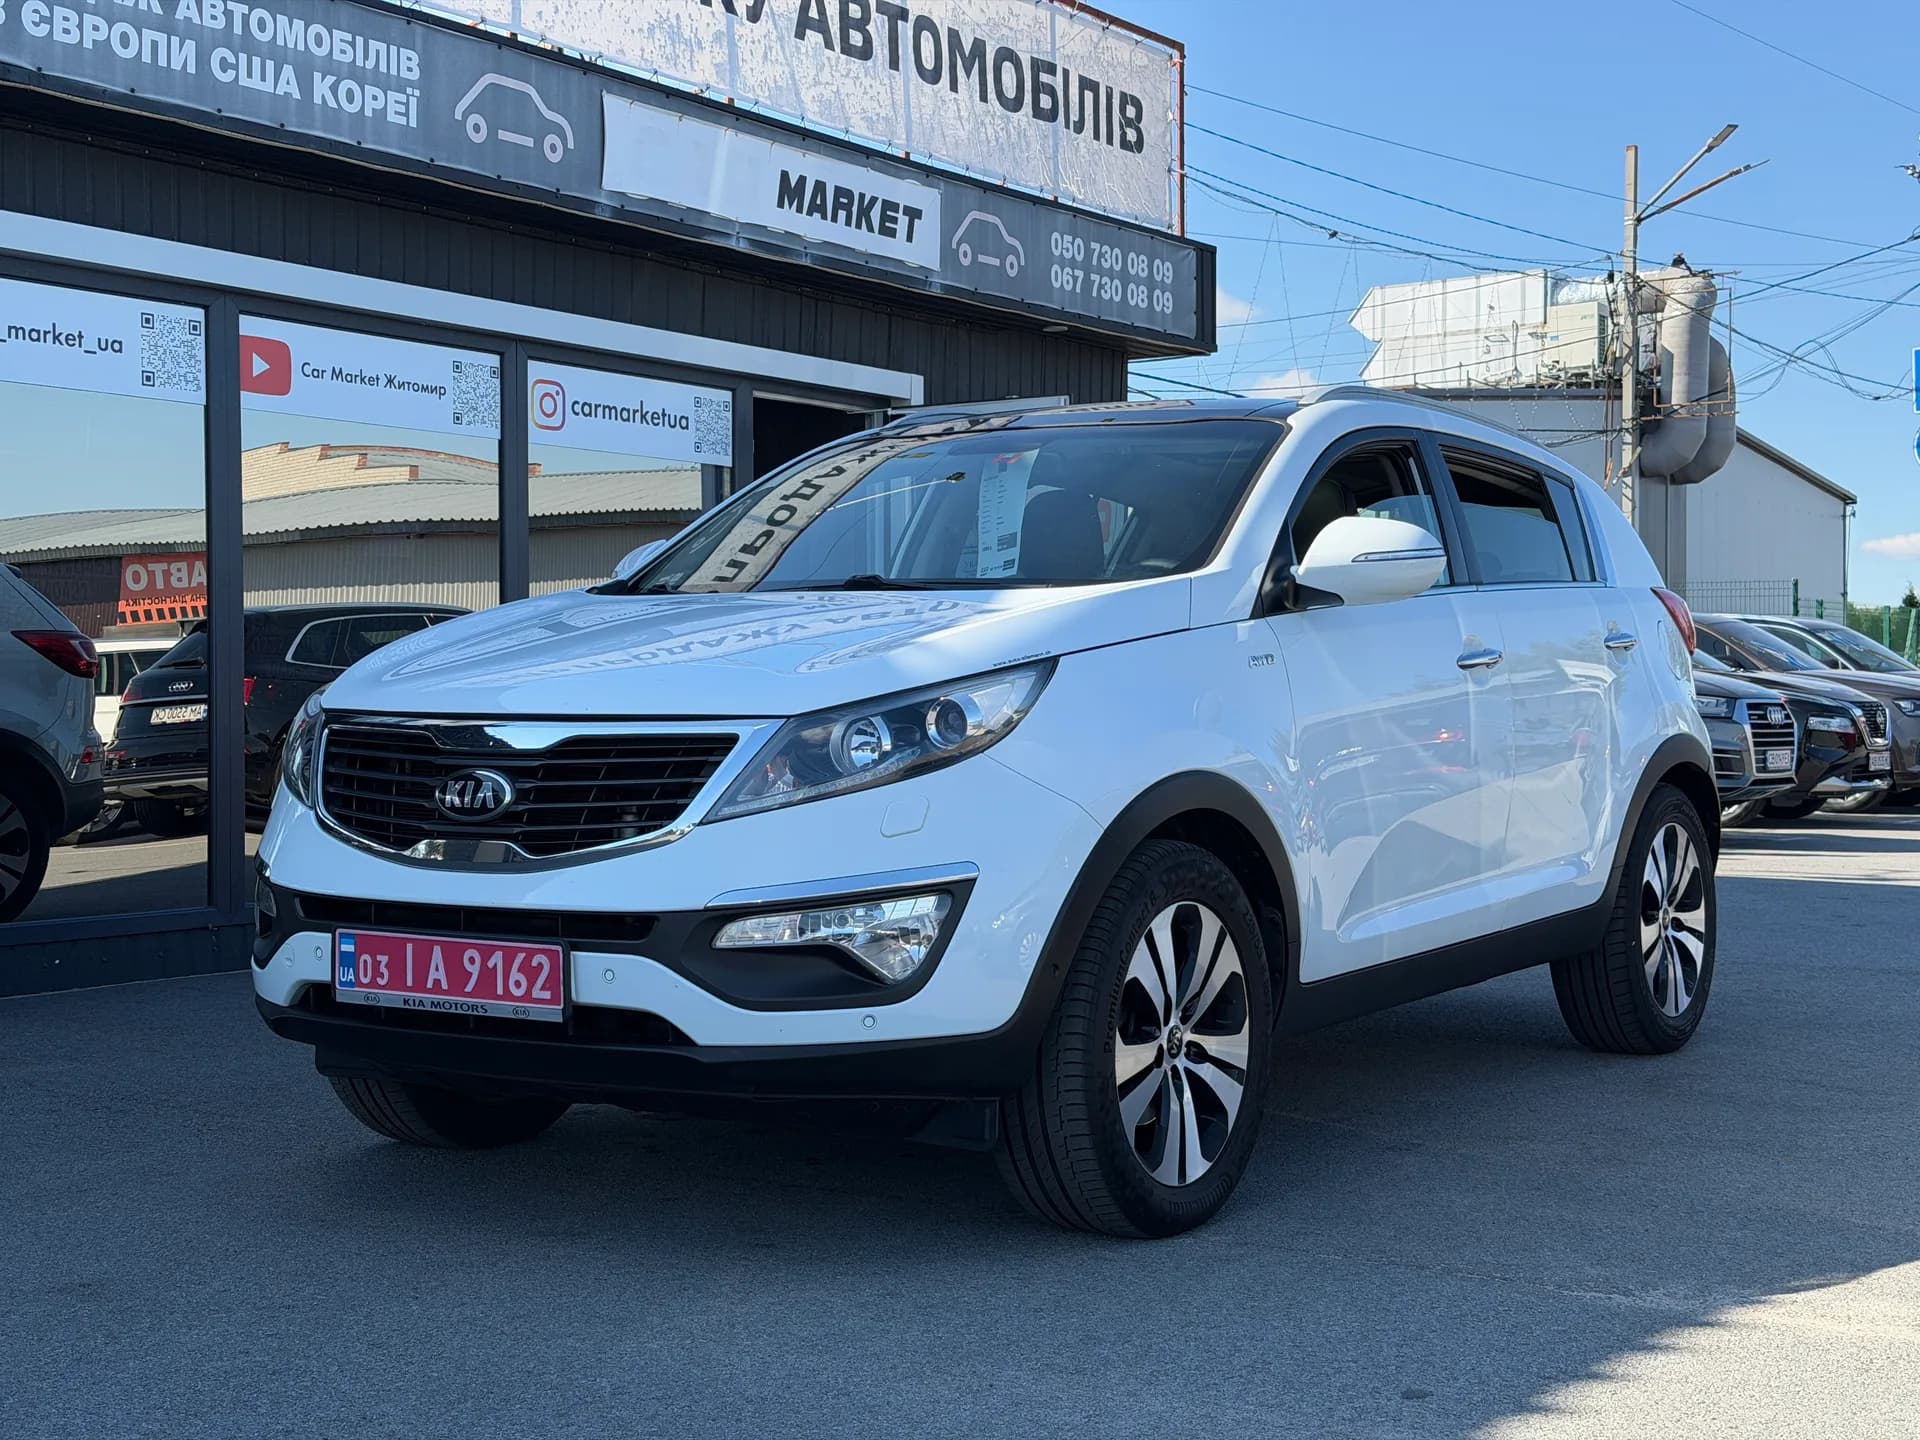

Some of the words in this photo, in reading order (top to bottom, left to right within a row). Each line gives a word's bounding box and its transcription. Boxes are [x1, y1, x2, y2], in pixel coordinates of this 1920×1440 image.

[21, 0, 196, 74] ЄВРОПИ
[210, 47, 301, 100] США
[313, 71, 420, 128] КОРЕЇ
[175, 0, 421, 81] АВТОМОБІЛІВ
[794, 0, 1145, 155] АВТОМОБІЛІВ
[776, 169, 923, 243] MARKET
[1051, 231, 1084, 262] 050
[1090, 242, 1122, 271] 730
[1127, 252, 1148, 278] 08
[1153, 259, 1173, 284] 09
[1051, 264, 1084, 293] 067
[1090, 274, 1122, 302] 730
[1127, 283, 1148, 309] 08
[1153, 289, 1173, 314] 09
[301, 362, 327, 379] Car
[331, 366, 380, 387] Market
[384, 373, 447, 400] Житомир
[571, 400, 689, 430] carmarketua
[445, 781, 495, 808] KIA
[340, 967, 355, 982] UA
[359, 954, 389, 986] 03
[463, 949, 551, 1000] 9162
[402, 997, 426, 1009] KIA
[430, 999, 488, 1014] MOTORS
